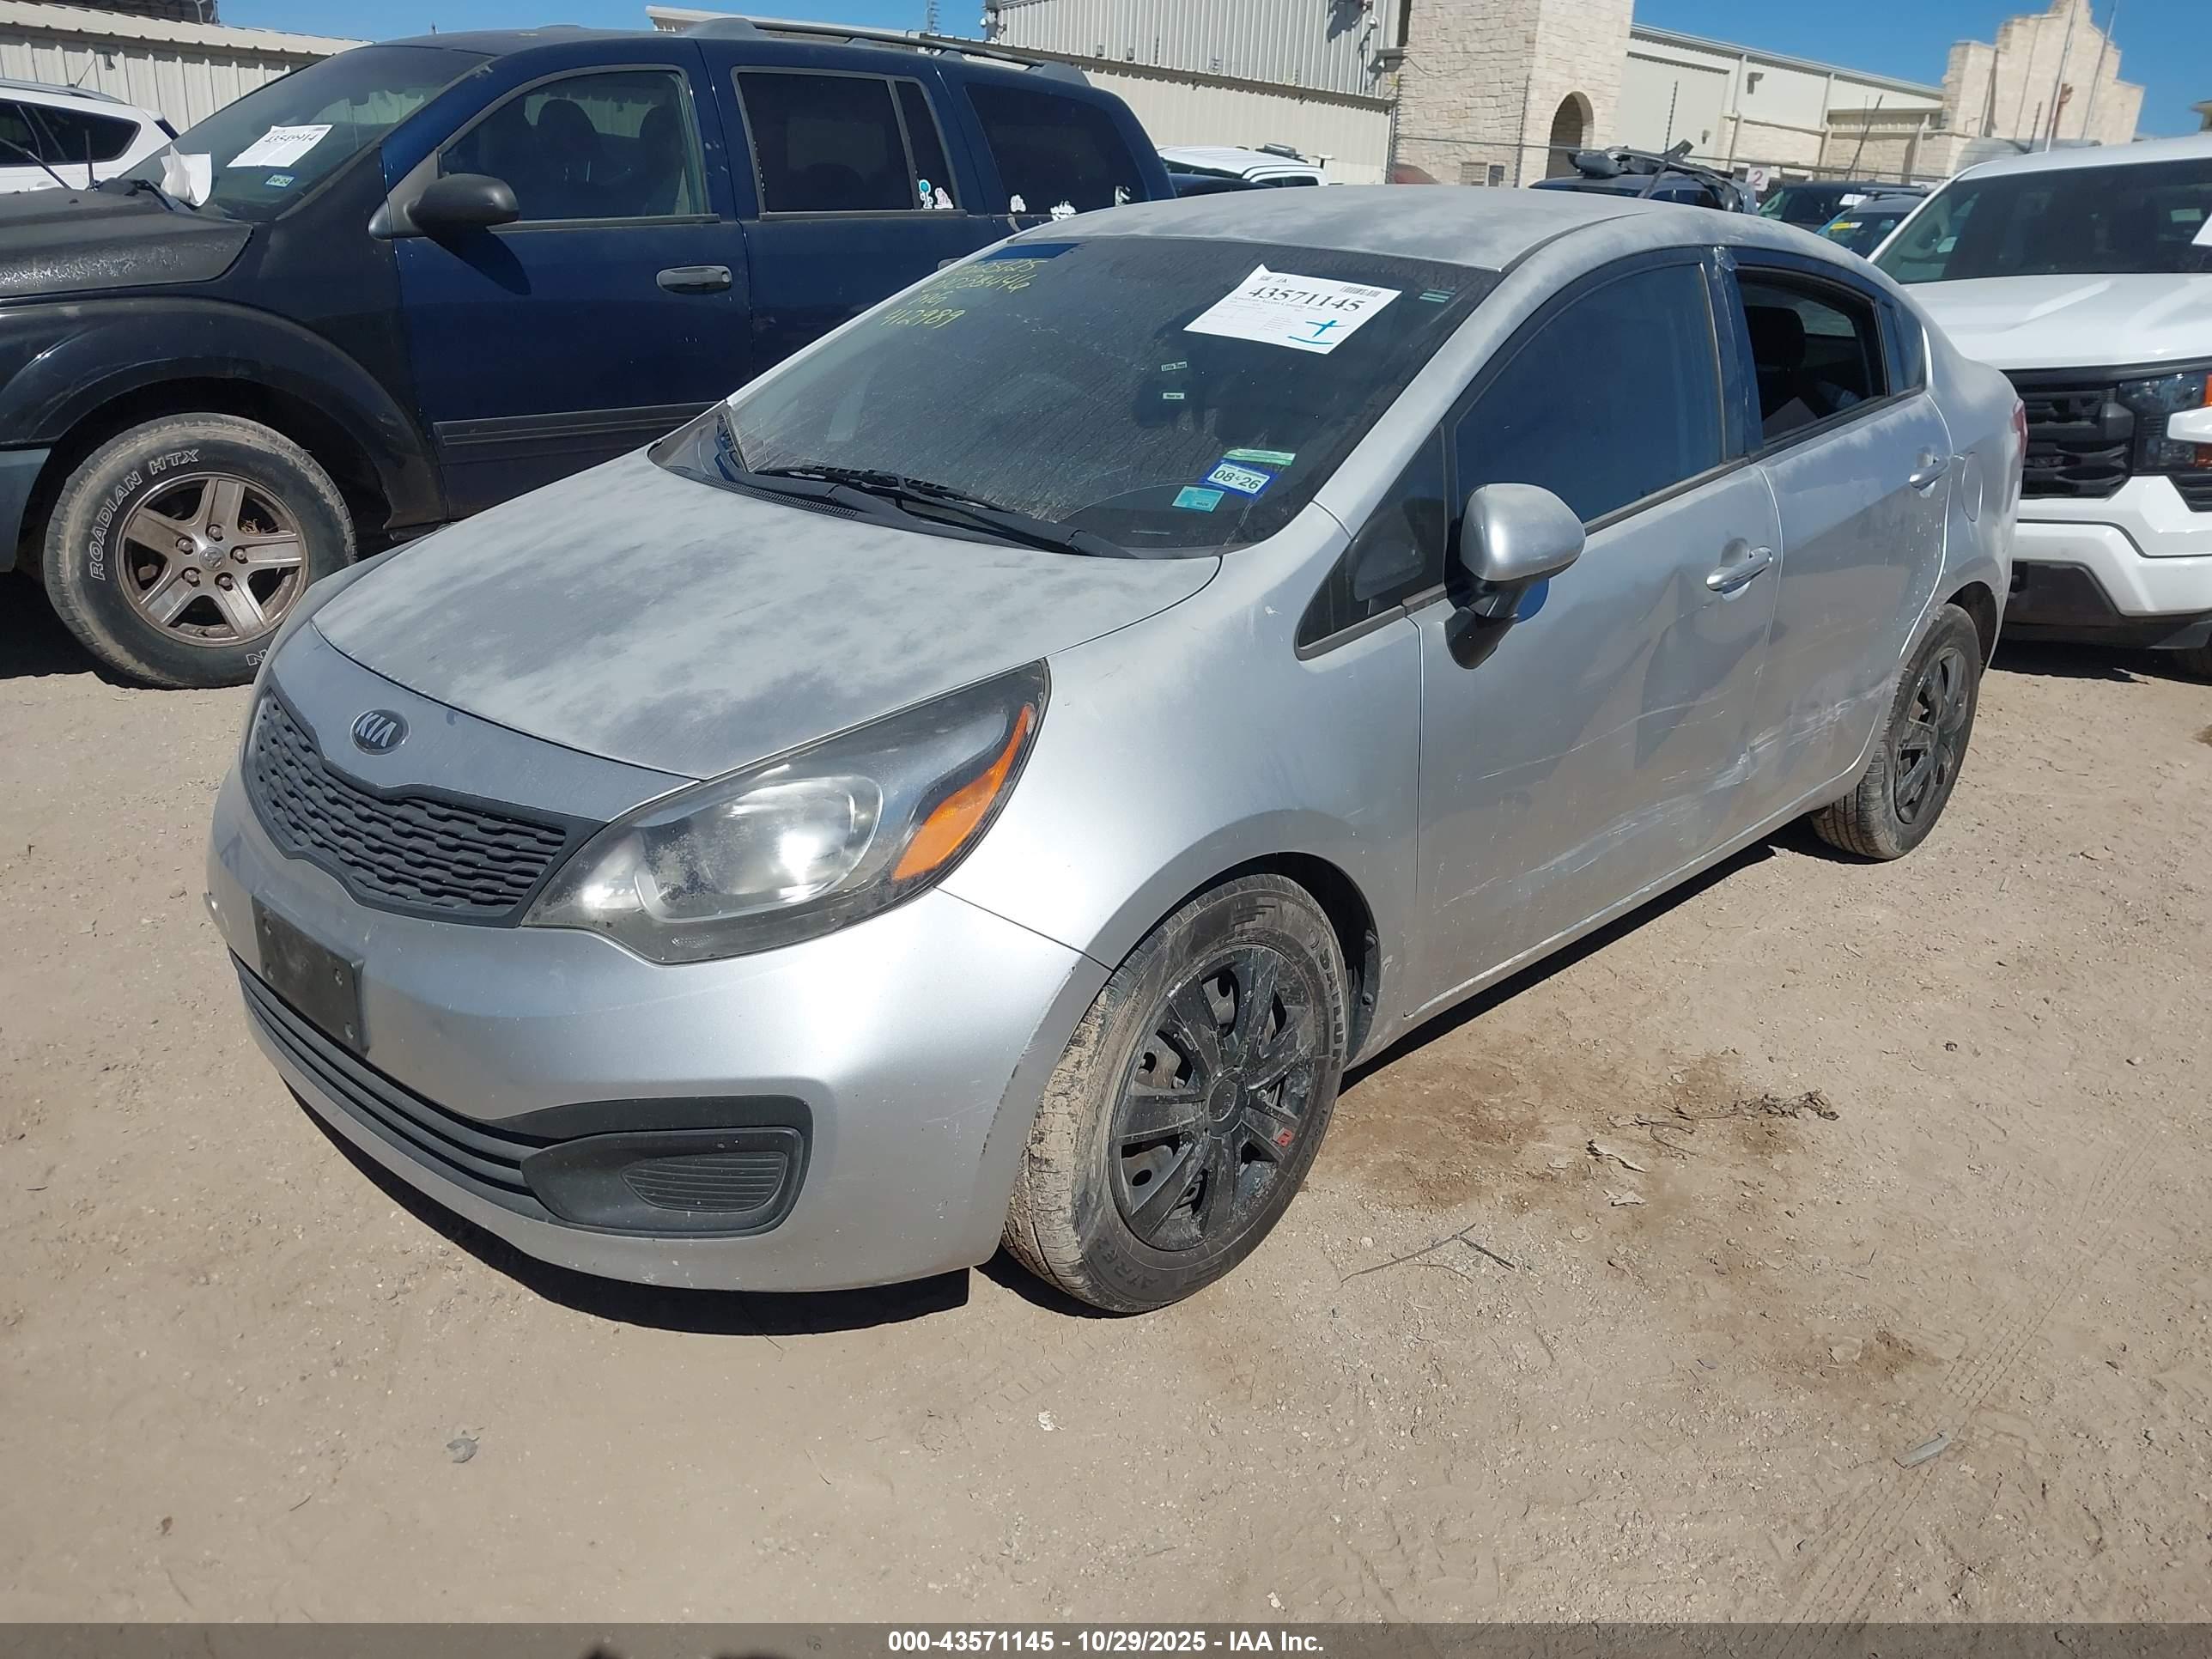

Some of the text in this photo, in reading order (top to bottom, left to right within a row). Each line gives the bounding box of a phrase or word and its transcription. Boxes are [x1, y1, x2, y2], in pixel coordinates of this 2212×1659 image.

[1753, 169, 1764, 185] 2
[1248, 285, 1367, 312] 43571145
[1213, 470, 1234, 483] 08
[1238, 477, 1261, 489] 26
[89, 448, 199, 580] ROADIAN HTX
[355, 712, 397, 747] KIA
